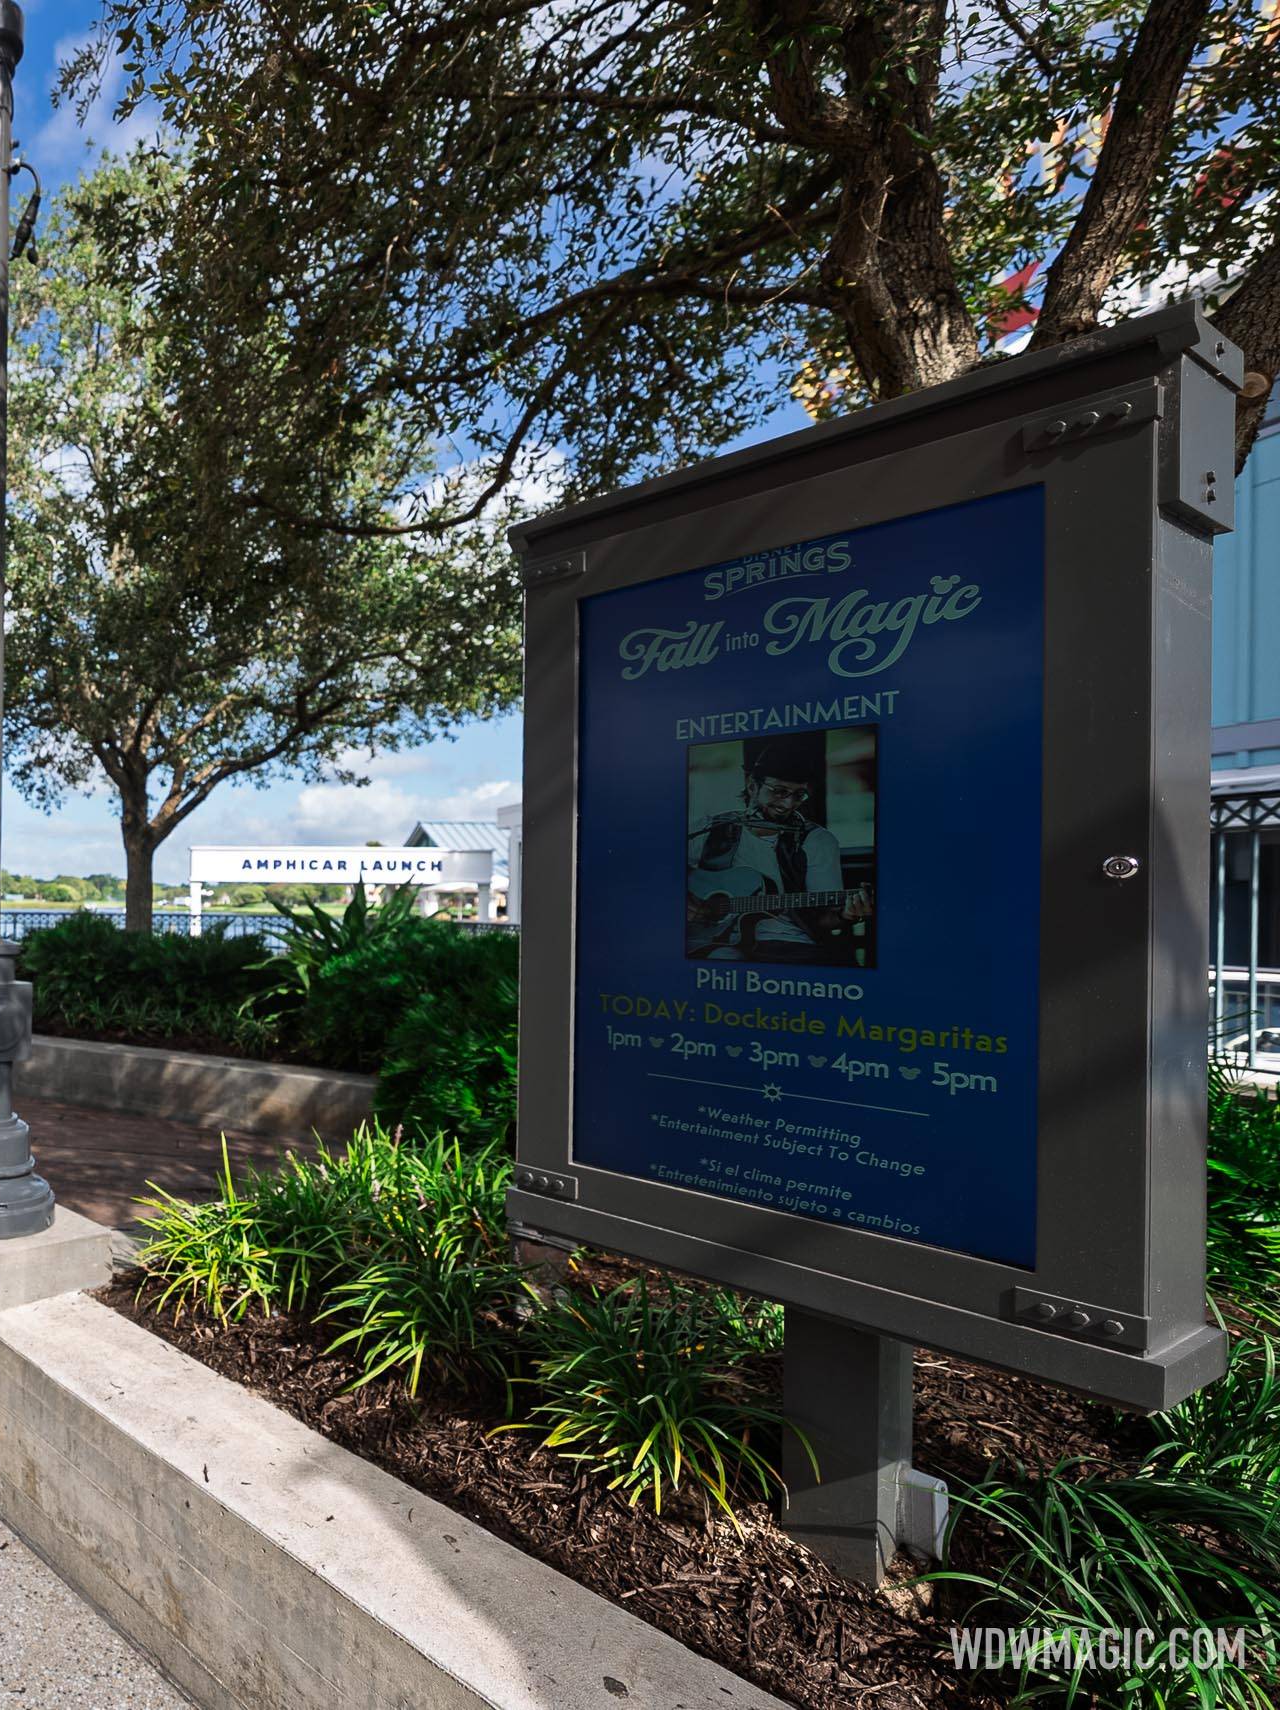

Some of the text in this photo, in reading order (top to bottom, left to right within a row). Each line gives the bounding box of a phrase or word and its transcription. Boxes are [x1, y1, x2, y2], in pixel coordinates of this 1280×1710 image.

[704, 541, 852, 600] SPRINGS
[619, 574, 982, 680] Fall into Magic
[675, 690, 900, 740] ENTERTAINMENT
[241, 859, 443, 871] AMPHICAR LAUNCH
[696, 968, 864, 1001] Phil Bonnano
[599, 994, 1008, 1054] TODAY: Dockside Margaritas
[607, 1026, 998, 1095] 1pm 2pm 3pm 4pm 5pm
[776, 1118, 861, 1148] Permitting
[763, 1134, 823, 1156] Subject
[829, 1146, 849, 1161] To
[856, 1151, 926, 1177] Change
[725, 1164, 739, 1177] el
[743, 1167, 782, 1186] clima
[786, 1179, 853, 1201] permite
[778, 1195, 828, 1214] sujeto
[832, 1208, 842, 1218] a
[847, 1210, 920, 1235] cambios
